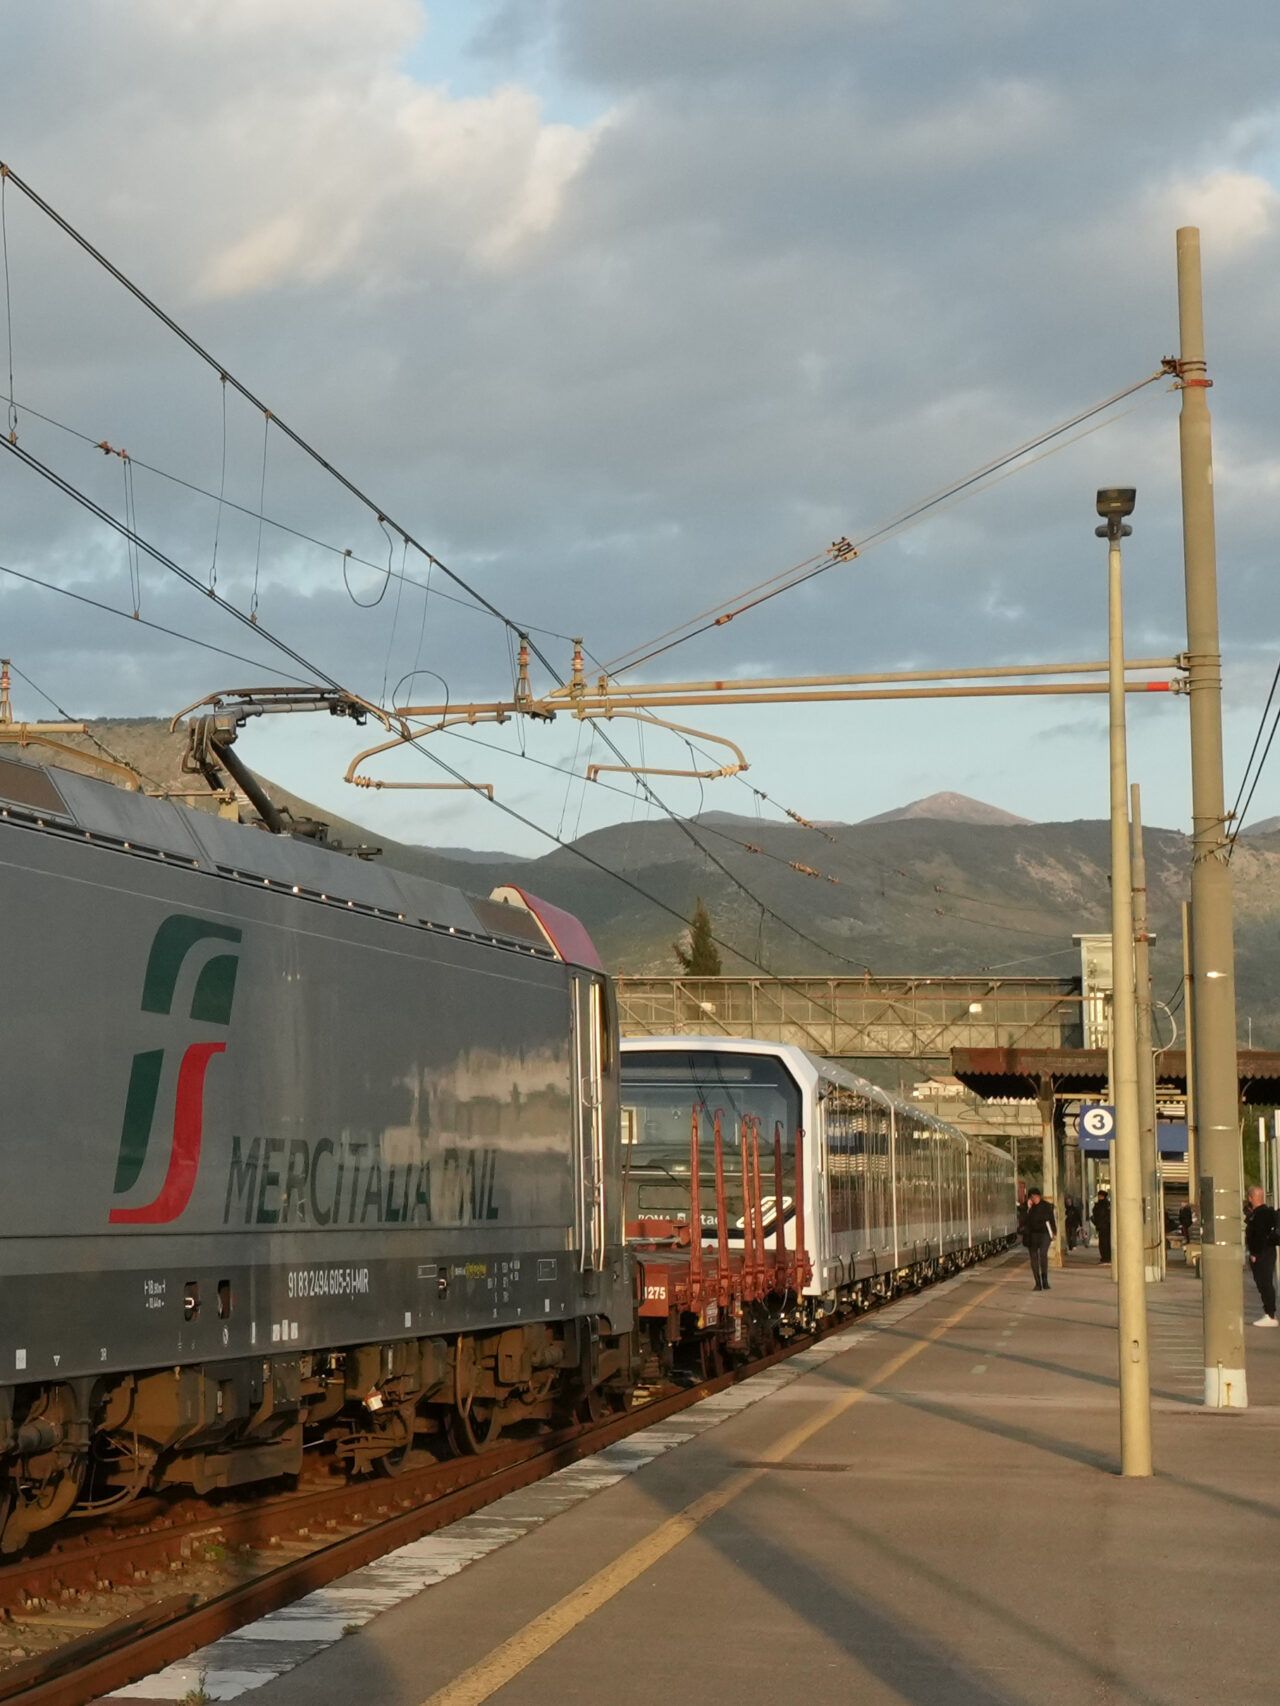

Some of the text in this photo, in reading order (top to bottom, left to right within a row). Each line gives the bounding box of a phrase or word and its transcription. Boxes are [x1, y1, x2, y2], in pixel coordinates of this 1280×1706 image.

[1091, 1114, 1106, 1130] 3
[223, 1135, 432, 1226] MERCITALIA
[288, 1271, 297, 1298] 91
[298, 1271, 308, 1297] 83
[309, 1270, 328, 1297] 2494
[329, 1268, 350, 1295] 605-5
